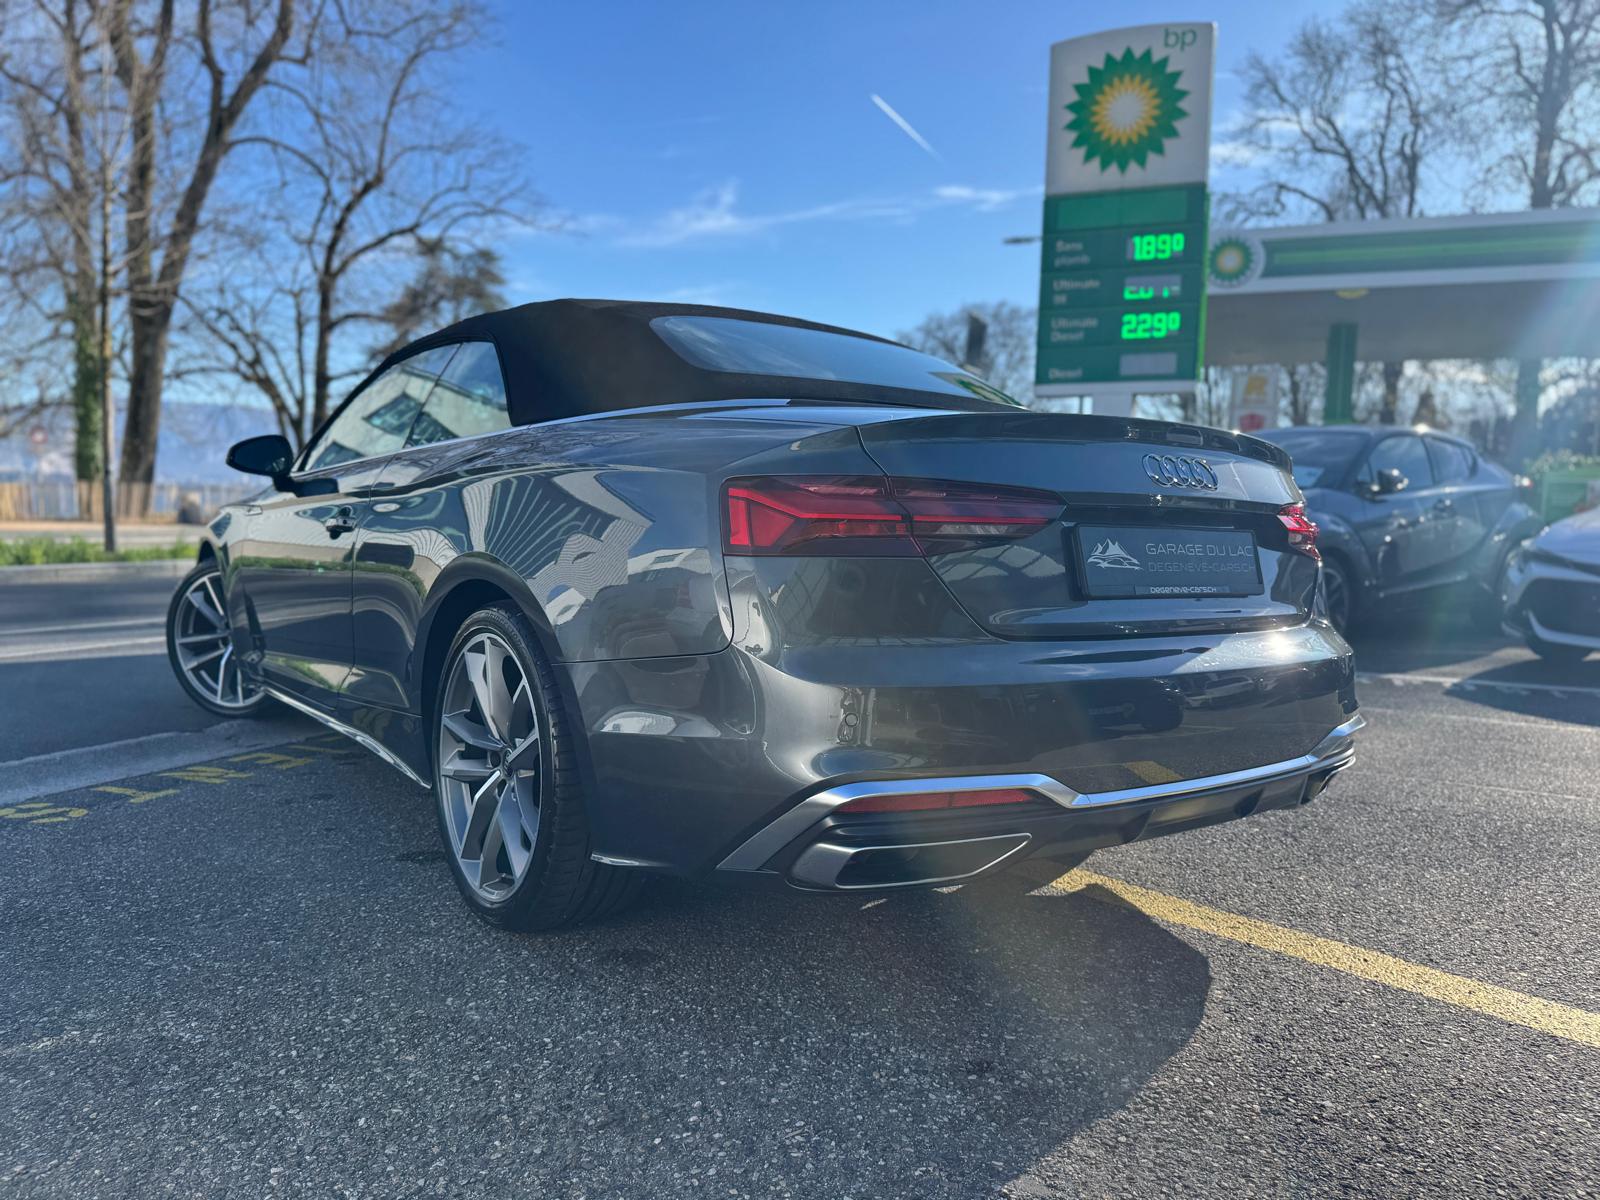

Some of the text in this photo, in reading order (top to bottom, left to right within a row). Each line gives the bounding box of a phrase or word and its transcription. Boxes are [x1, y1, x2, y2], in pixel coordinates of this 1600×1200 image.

[1163, 27, 1198, 53] bp
[1145, 543, 1254, 557] GARAGE DU LAC
